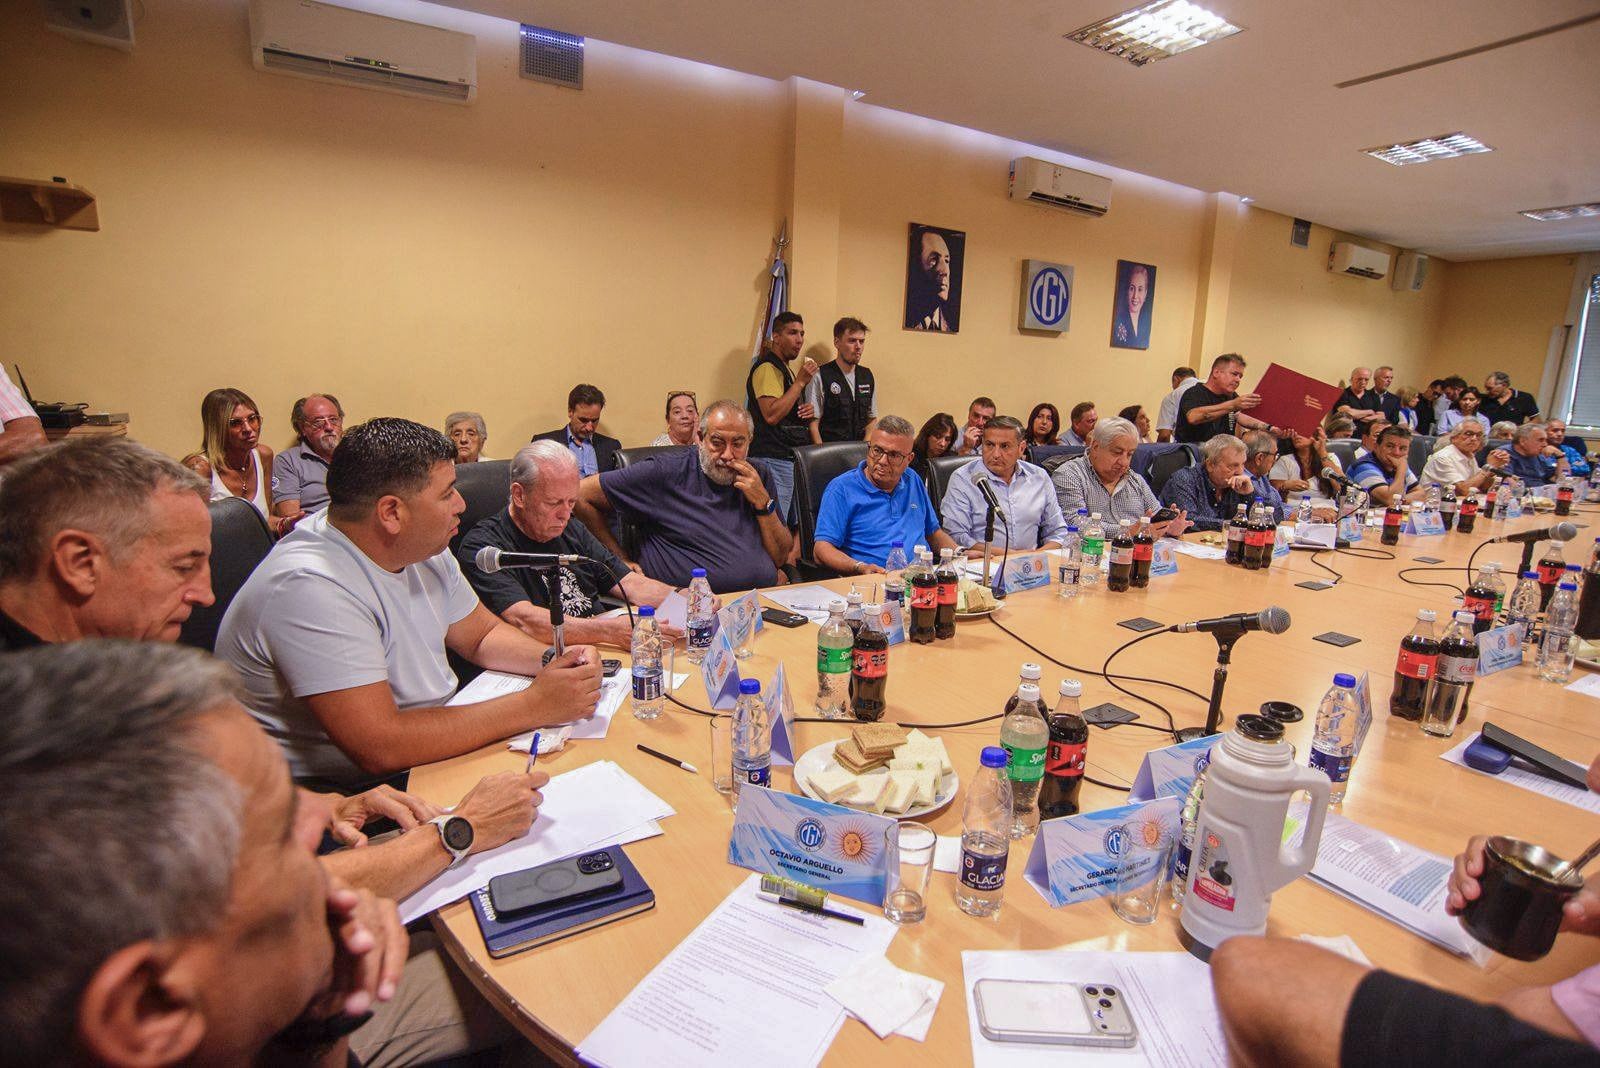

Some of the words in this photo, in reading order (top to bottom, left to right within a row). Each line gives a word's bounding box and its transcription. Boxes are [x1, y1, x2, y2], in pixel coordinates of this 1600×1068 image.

[1032, 271, 1067, 322] CGT
[769, 848, 802, 864] OCTAVIO
[803, 858, 844, 875] ARGUELLO
[777, 861, 808, 874] SECRETARIO
[808, 869, 831, 881] GENERAL
[968, 872, 1005, 885] GLACIA
